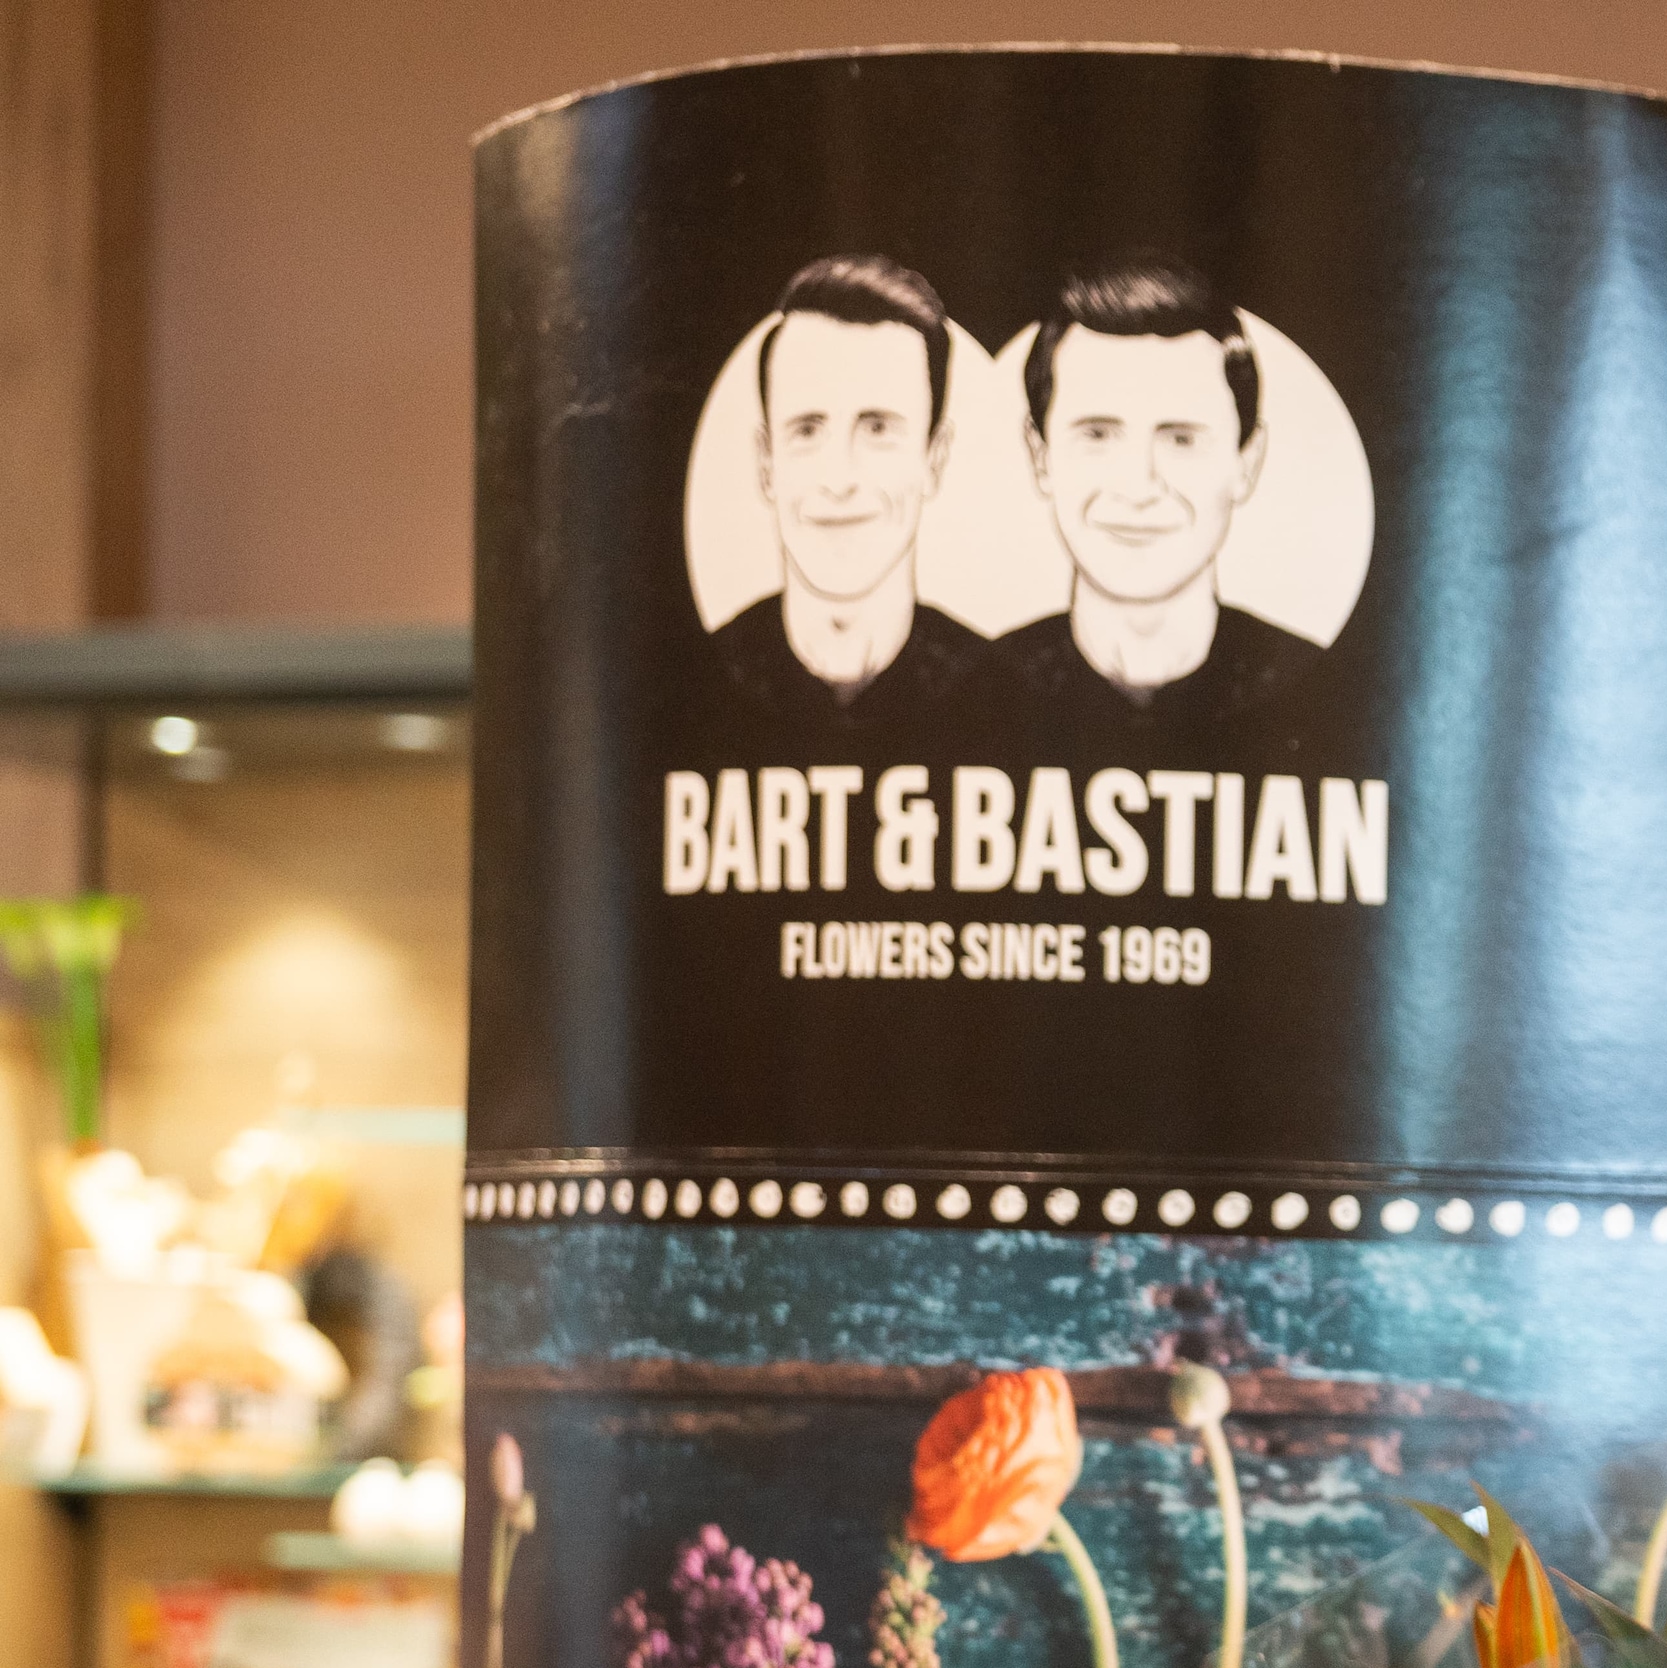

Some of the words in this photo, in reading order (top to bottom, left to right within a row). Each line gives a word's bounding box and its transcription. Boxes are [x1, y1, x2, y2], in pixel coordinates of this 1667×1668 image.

[663, 766, 864, 895] BART
[874, 764, 938, 892] &
[951, 766, 1389, 906] BASTIAN
[780, 921, 955, 980] FLOWERS
[961, 922, 1085, 982] SINCE
[1098, 926, 1211, 985] 1969
